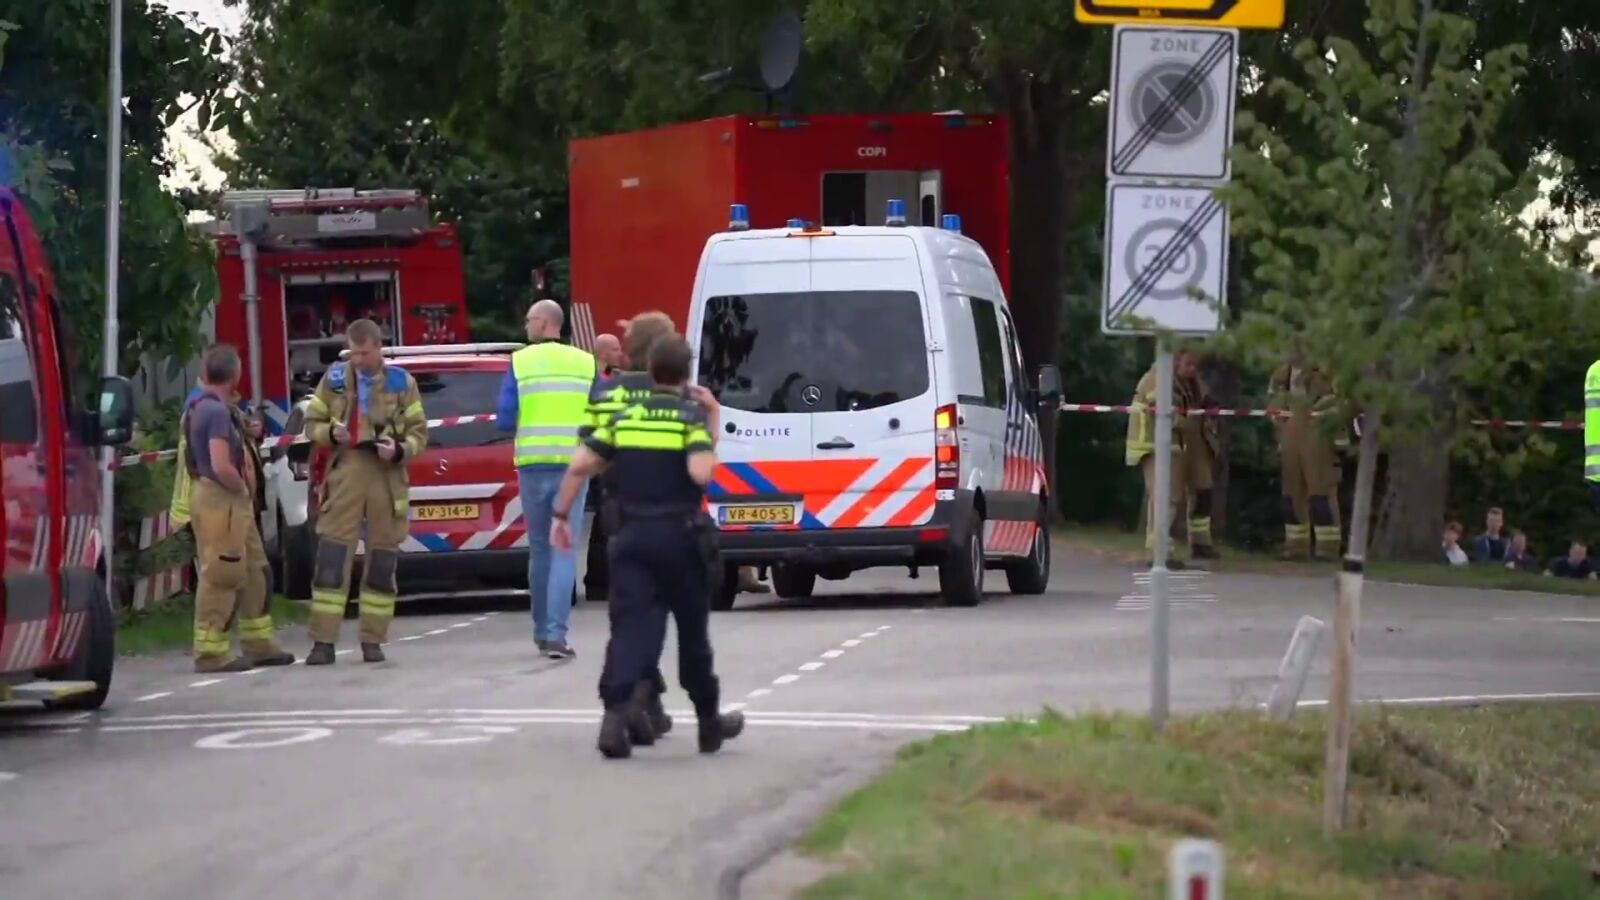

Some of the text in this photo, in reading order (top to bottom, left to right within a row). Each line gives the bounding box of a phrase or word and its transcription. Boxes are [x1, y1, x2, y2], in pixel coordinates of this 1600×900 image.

[1150, 37, 1201, 53] ZONE
[857, 146, 887, 157] COPI
[1141, 193, 1196, 210] ZONE
[1142, 244, 1191, 275] 30
[736, 427, 791, 437] POLITIE
[418, 506, 472, 518] RV-314-P
[729, 507, 789, 521] VR-405-S
